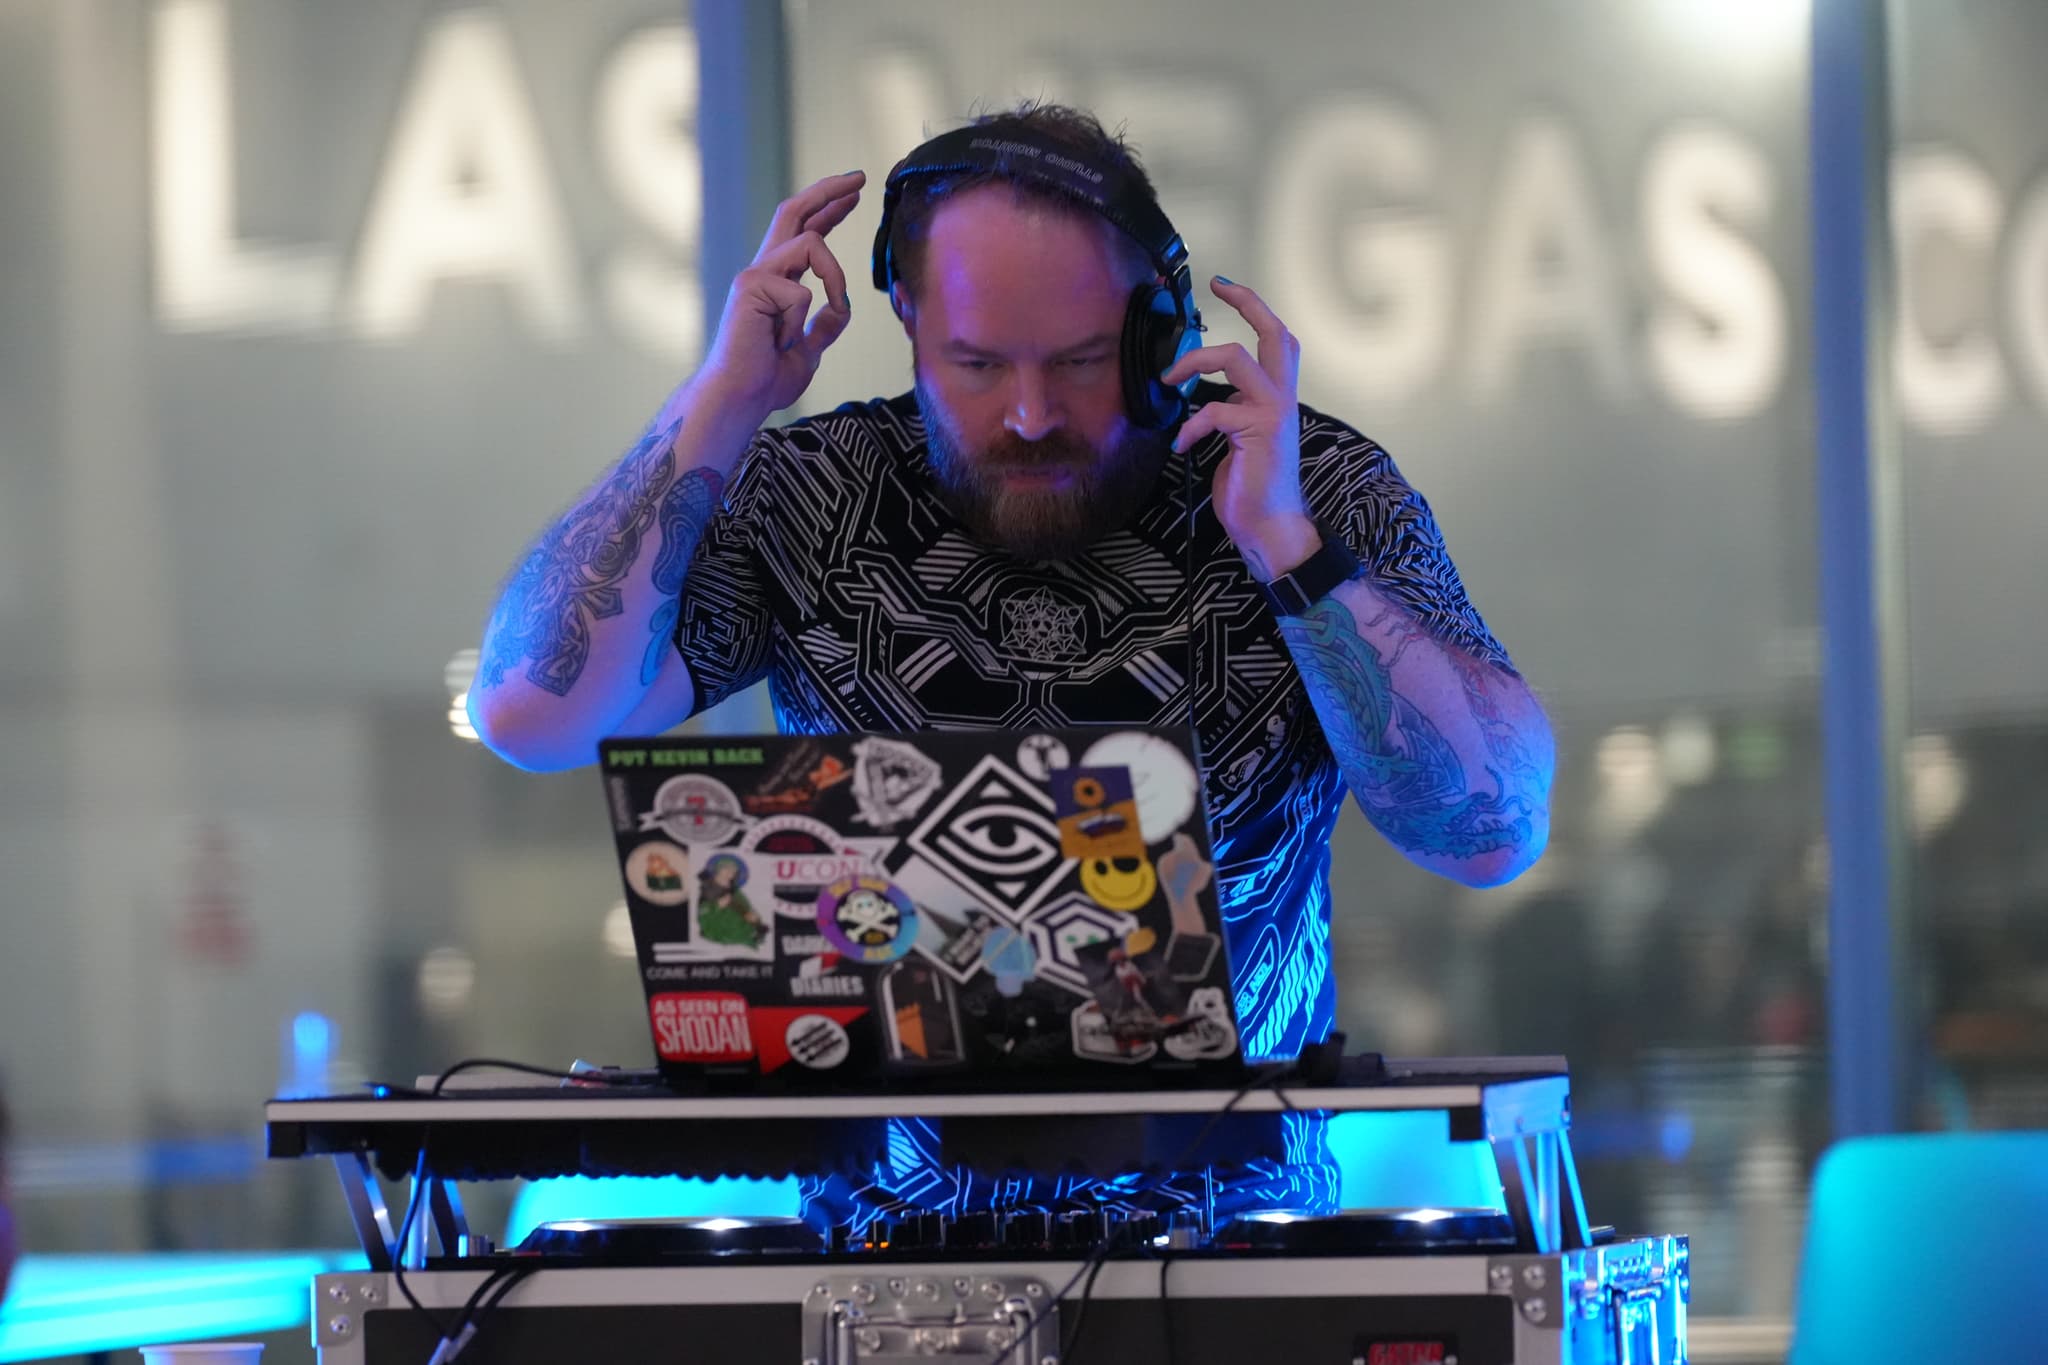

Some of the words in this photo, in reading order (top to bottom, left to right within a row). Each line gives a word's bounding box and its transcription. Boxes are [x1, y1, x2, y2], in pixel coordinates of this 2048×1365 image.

[150, 0, 705, 360] LAS
[650, 749, 710, 766] KEVIN
[713, 747, 764, 765] BACK
[646, 966, 688, 980] COME
[691, 966, 721, 979] AND
[723, 965, 758, 979] TAKE
[761, 965, 773, 978] IT
[790, 976, 864, 997] DIARIES
[655, 1001, 677, 1014] AS
[680, 1000, 719, 1013] SEEN
[722, 999, 745, 1013] ON
[656, 1015, 753, 1054] SHODAN
